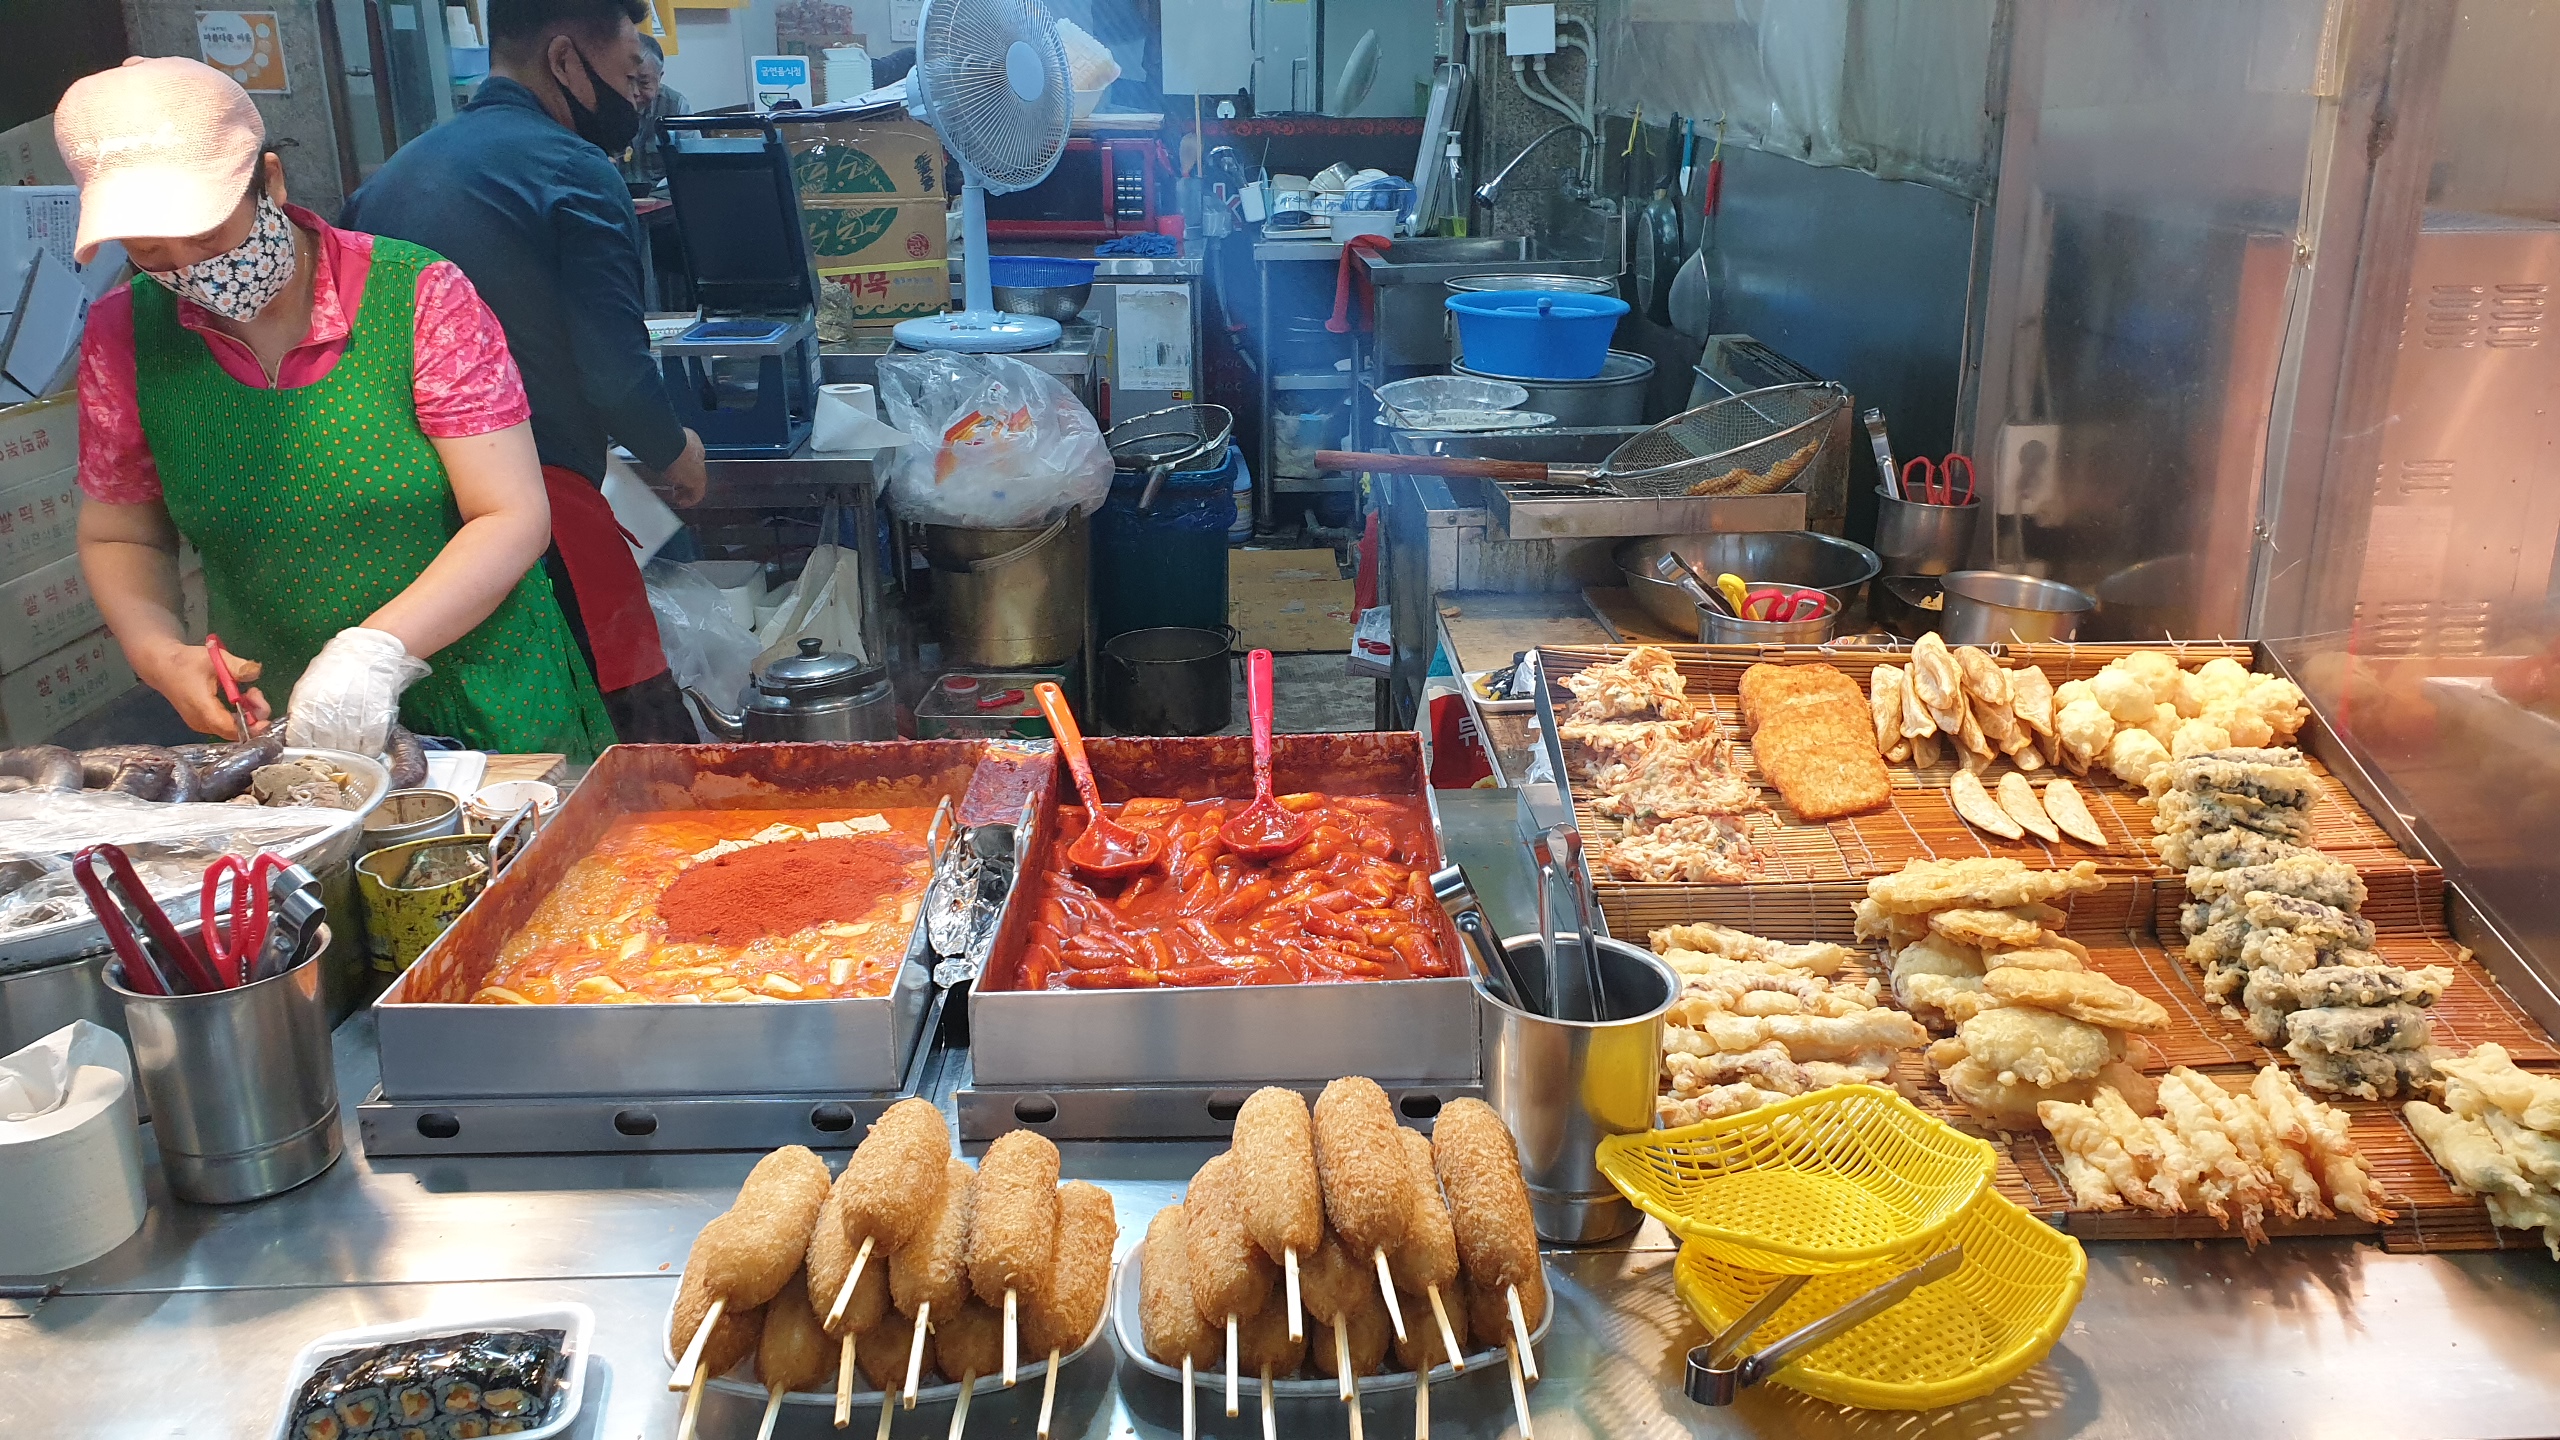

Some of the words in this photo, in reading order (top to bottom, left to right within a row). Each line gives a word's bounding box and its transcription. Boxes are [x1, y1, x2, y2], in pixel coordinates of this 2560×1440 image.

[761, 66, 801, 77] 금연음식점
[0, 429, 49, 461] 쌀떡볶
[24, 575, 79, 617] 쌀떡볶
[36, 643, 105, 697] 쌀떡볶이
